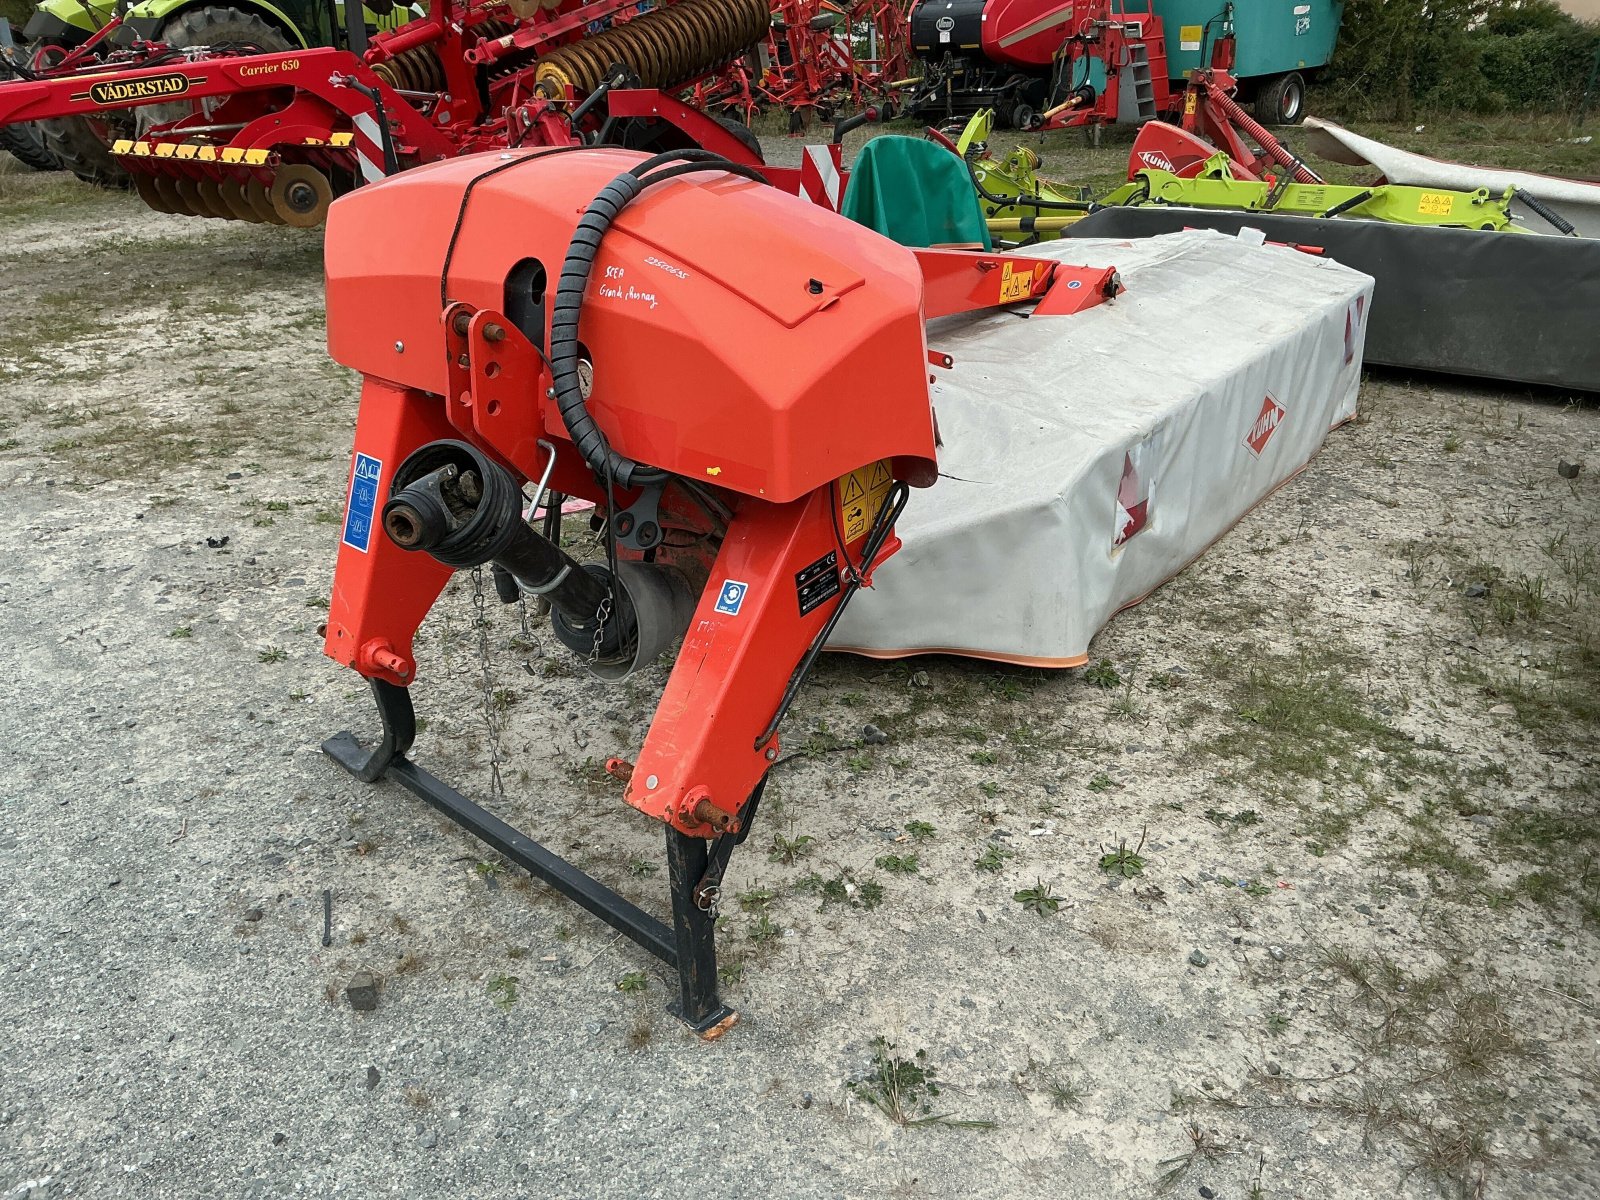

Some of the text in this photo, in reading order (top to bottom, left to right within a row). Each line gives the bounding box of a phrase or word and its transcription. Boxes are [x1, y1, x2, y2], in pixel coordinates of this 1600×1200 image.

[239, 59, 300, 77] Carrier 650
[97, 77, 183, 101] VÄDERSTAD
[1142, 152, 1172, 171] KUHN
[604, 265, 625, 279] SCEA
[1250, 406, 1279, 445] KUHN
